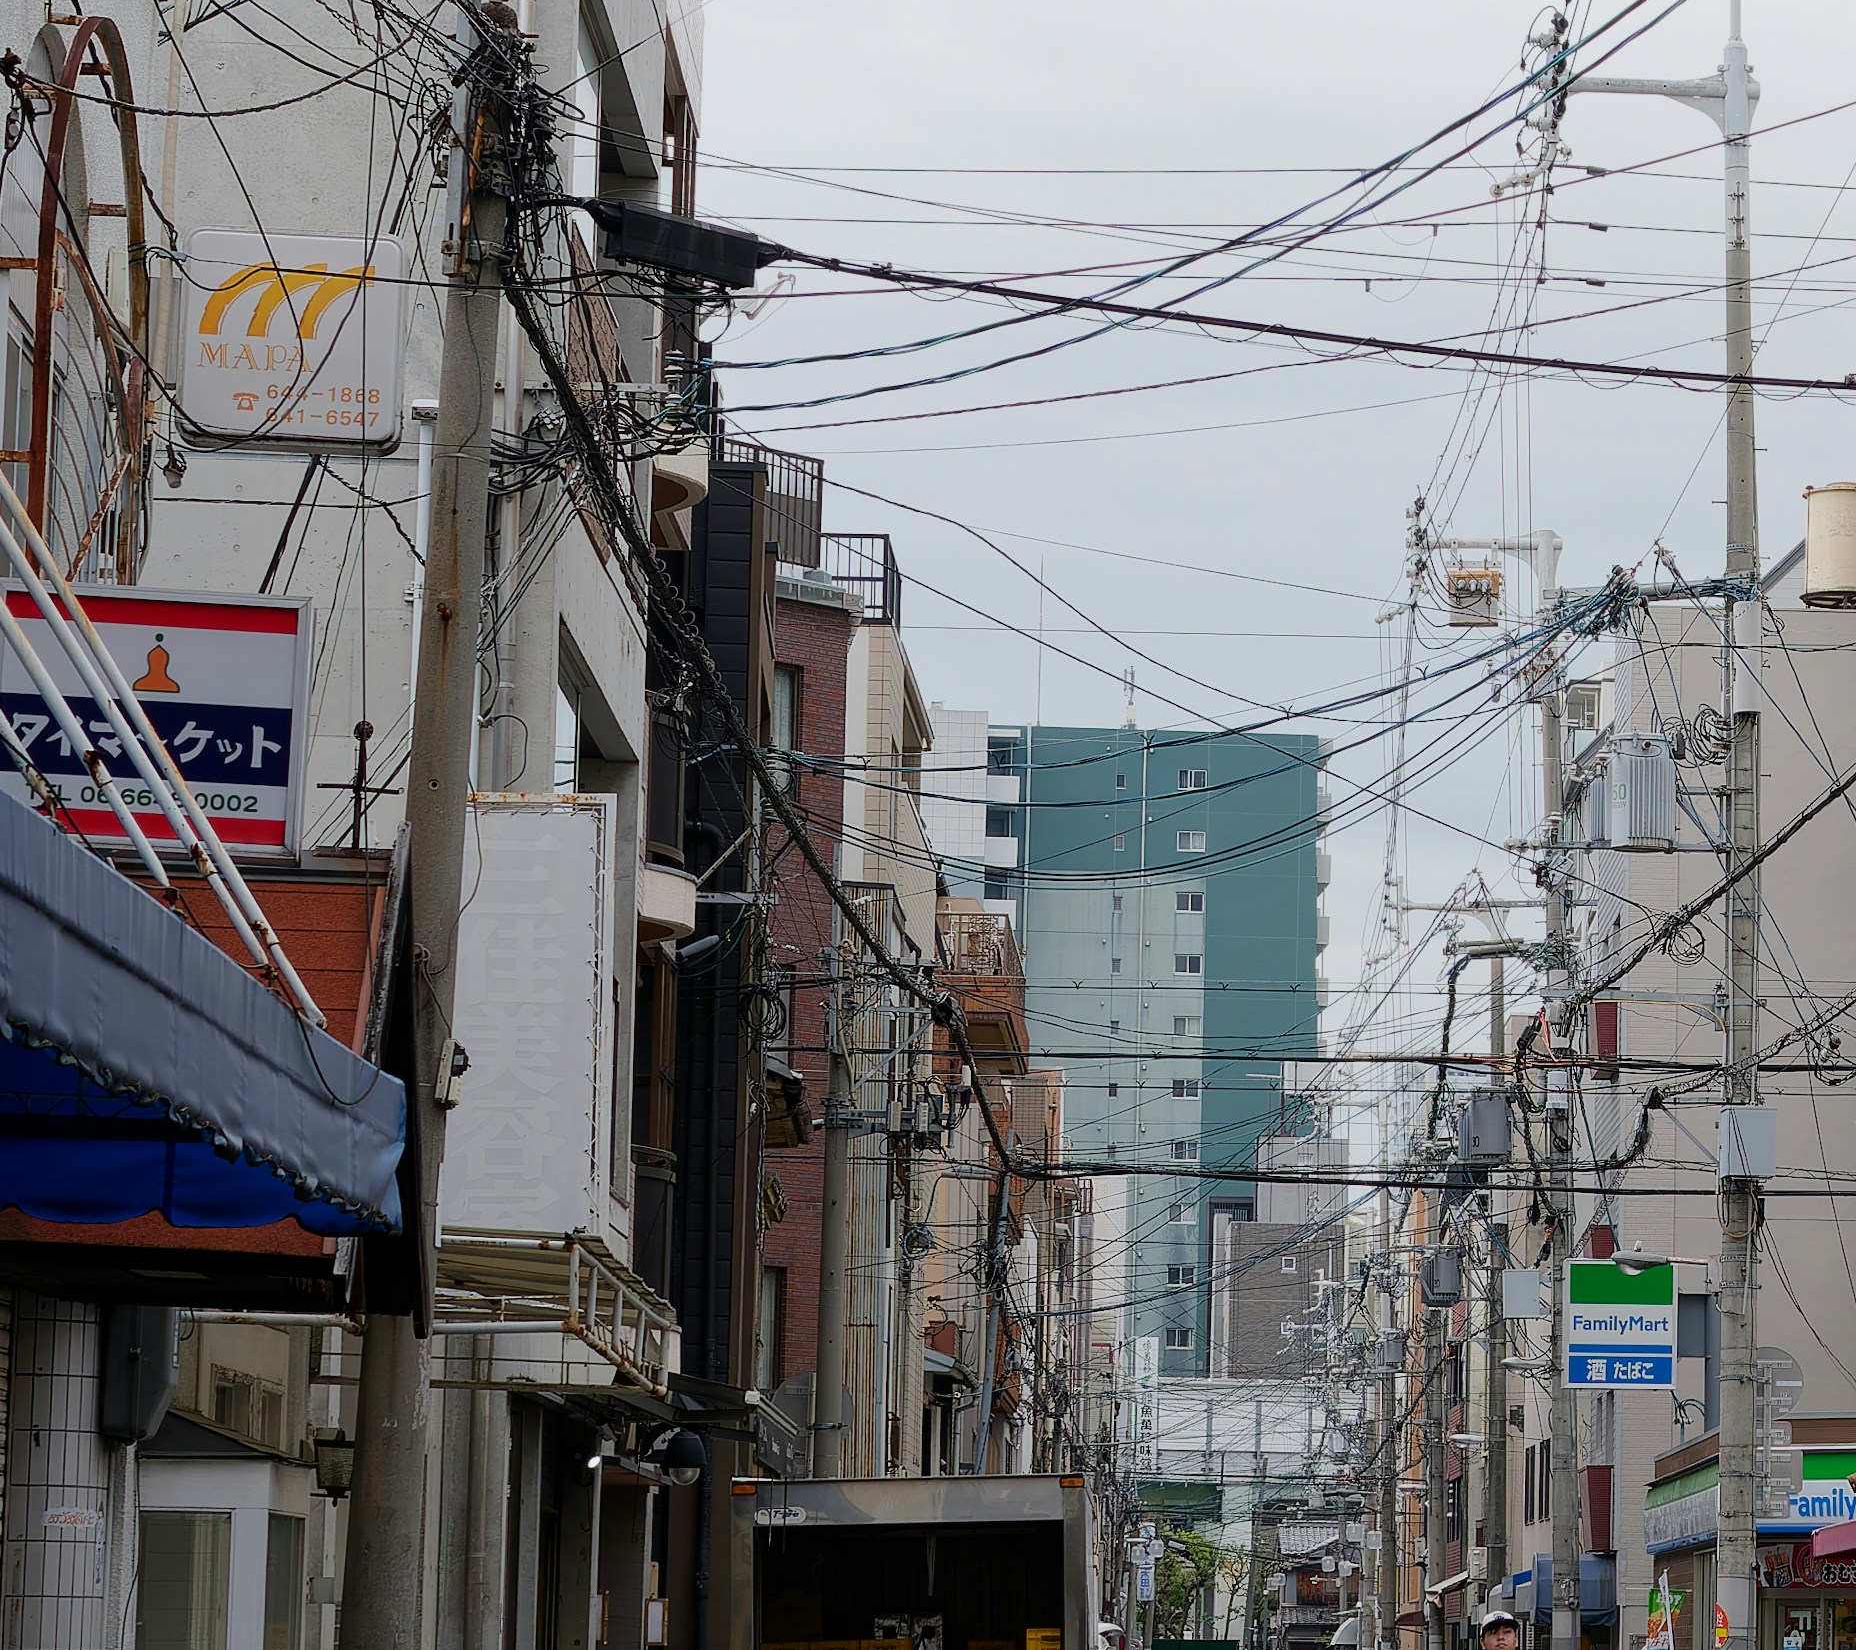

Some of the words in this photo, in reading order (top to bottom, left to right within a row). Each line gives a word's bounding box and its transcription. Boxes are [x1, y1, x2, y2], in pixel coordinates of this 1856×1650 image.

[197, 341, 314, 373] MAPA
[267, 384, 380, 404] 644-1868
[265, 407, 380, 427] 641-6547
[1573, 1315, 1669, 1335] FamilyMart
[1586, 1358, 1608, 1381] 酒
[1613, 1361, 1654, 1380] たばこ
